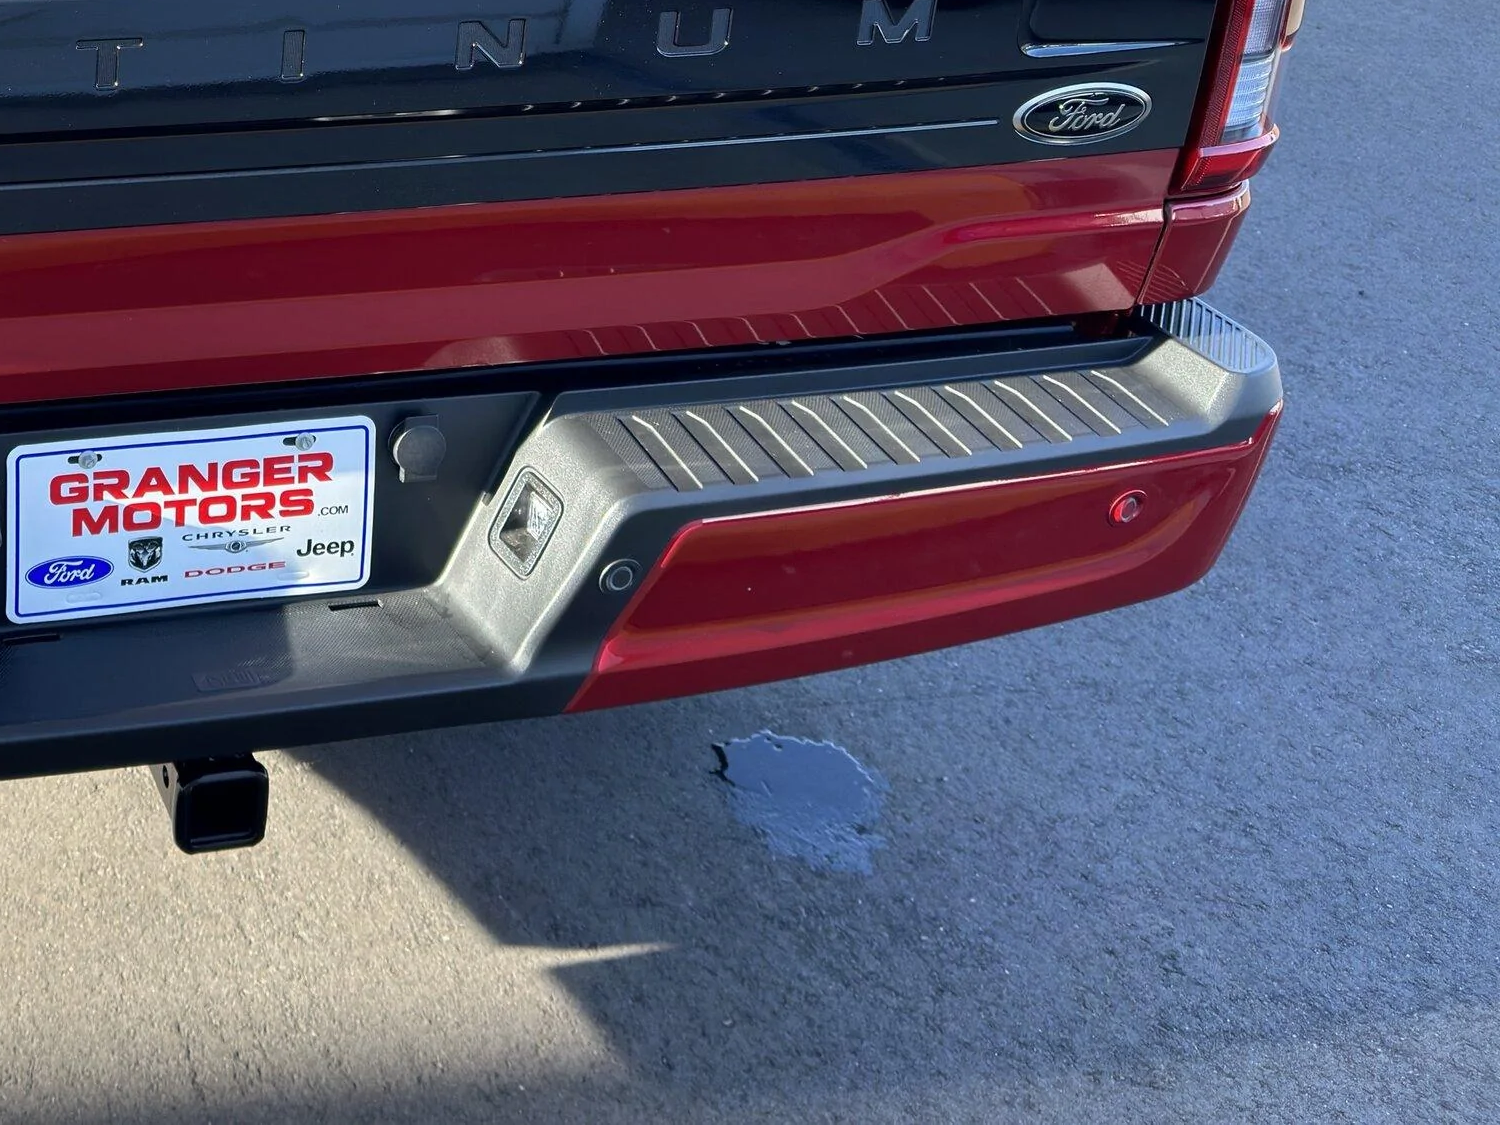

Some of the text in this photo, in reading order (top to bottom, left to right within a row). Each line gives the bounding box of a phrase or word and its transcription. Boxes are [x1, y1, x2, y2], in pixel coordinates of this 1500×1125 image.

[1048, 97, 1127, 133] Ford
[50, 451, 334, 506] GRANGER
[71, 488, 349, 538] MOTORS .COM
[181, 525, 292, 542] CHRYSLER
[296, 538, 355, 558] Jeep
[43, 559, 96, 585] Ford
[120, 574, 169, 587] RAM
[184, 560, 287, 579] DODGE
